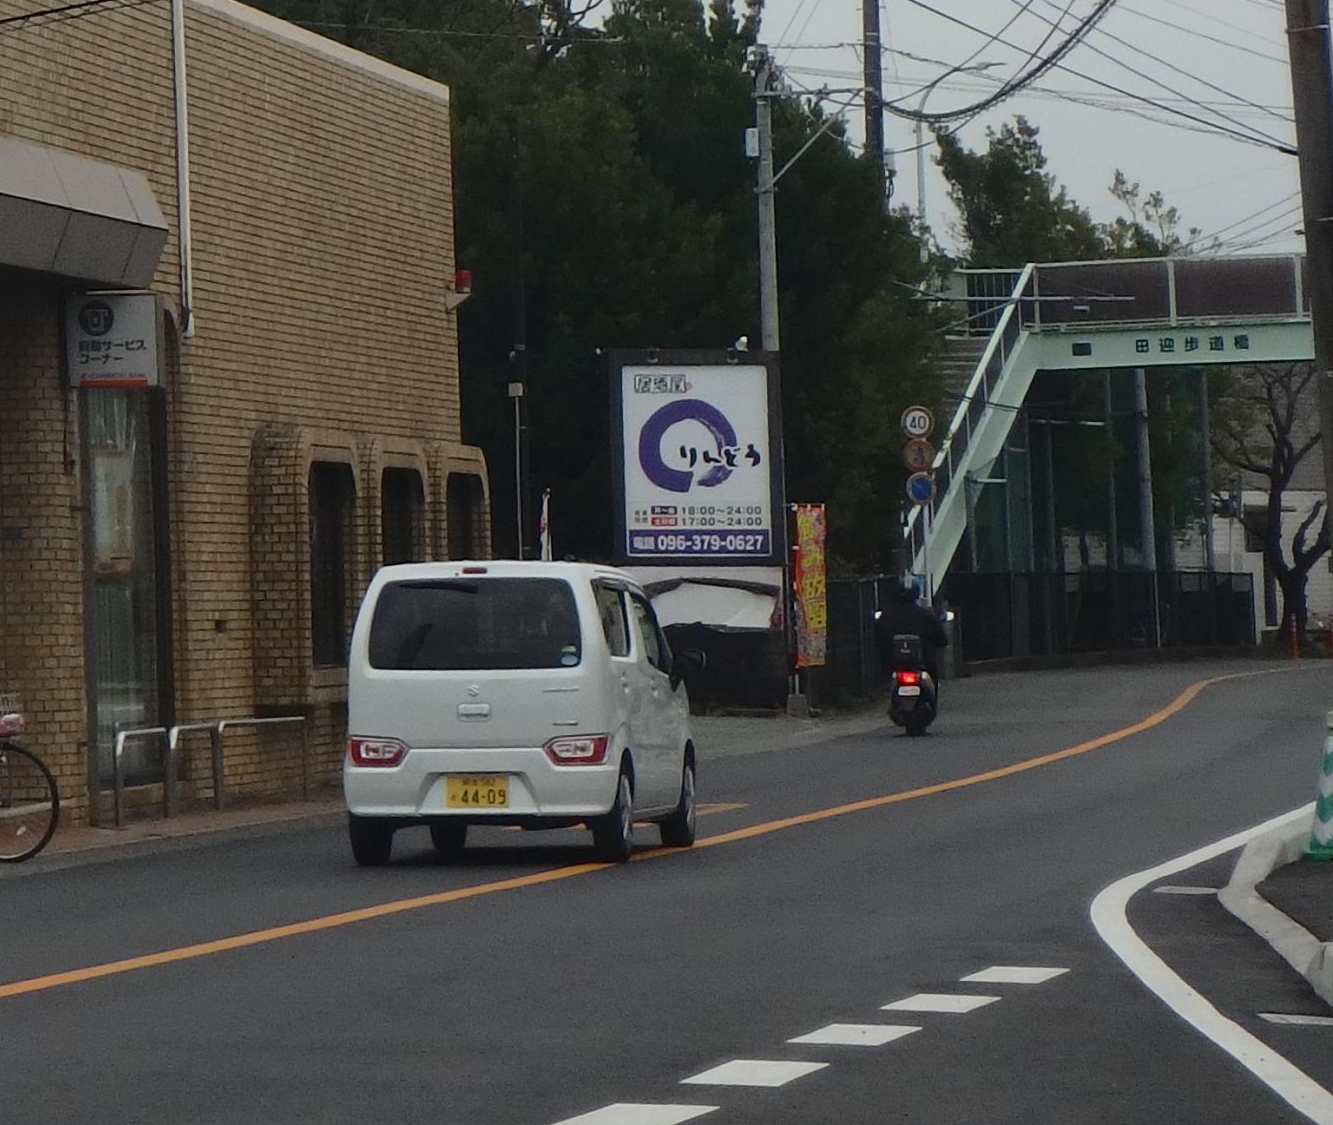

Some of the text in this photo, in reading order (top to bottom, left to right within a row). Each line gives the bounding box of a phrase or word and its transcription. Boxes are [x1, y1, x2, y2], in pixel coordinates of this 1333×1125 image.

[1136, 334, 1249, 352] 田迎歩道橋
[79, 354, 124, 364] コーナー
[909, 416, 926, 429] 40
[680, 444, 760, 467] りんどう
[657, 535, 764, 550] 096-379-0627
[461, 788, 506, 805] 44-09
